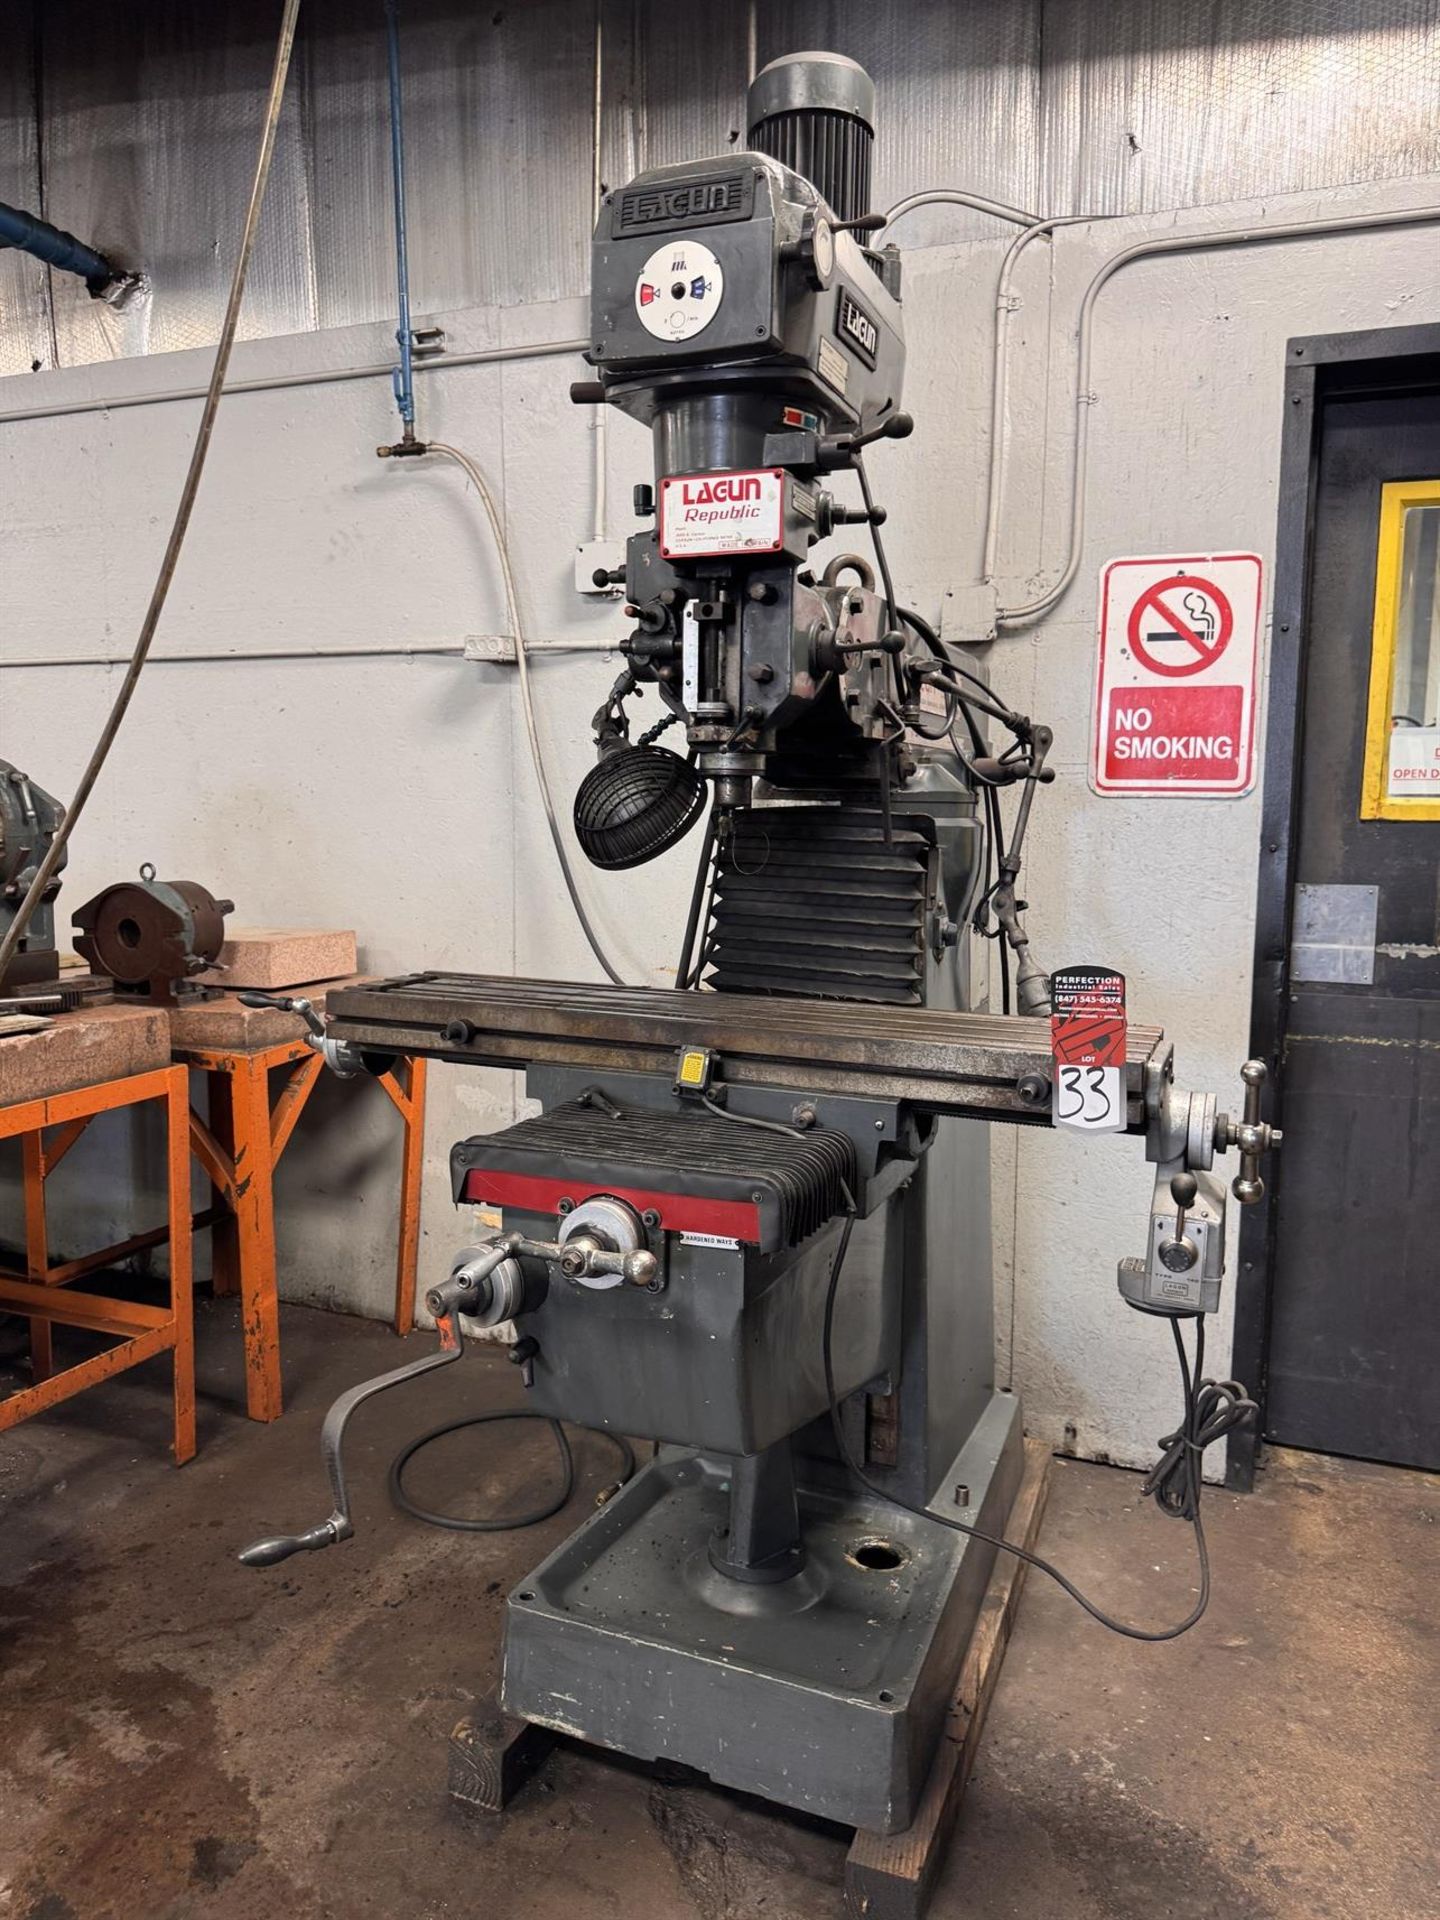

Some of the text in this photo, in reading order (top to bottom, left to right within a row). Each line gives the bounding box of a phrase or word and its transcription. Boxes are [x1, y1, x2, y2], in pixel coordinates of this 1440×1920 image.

[631, 184, 730, 220] LAGUN
[846, 302, 876, 353] LAGUN
[683, 478, 761, 505] LAGUN
[684, 504, 761, 524] Republic
[1115, 708, 1152, 731] NO
[1114, 736, 1233, 759] SMOKING
[1393, 768, 1427, 779] OPEN
[1055, 976, 1120, 984] PERFECTION
[1055, 995, 1078, 1004] (847)
[1058, 1066, 1111, 1122] 33
[686, 1235, 715, 1243] HARDENED
